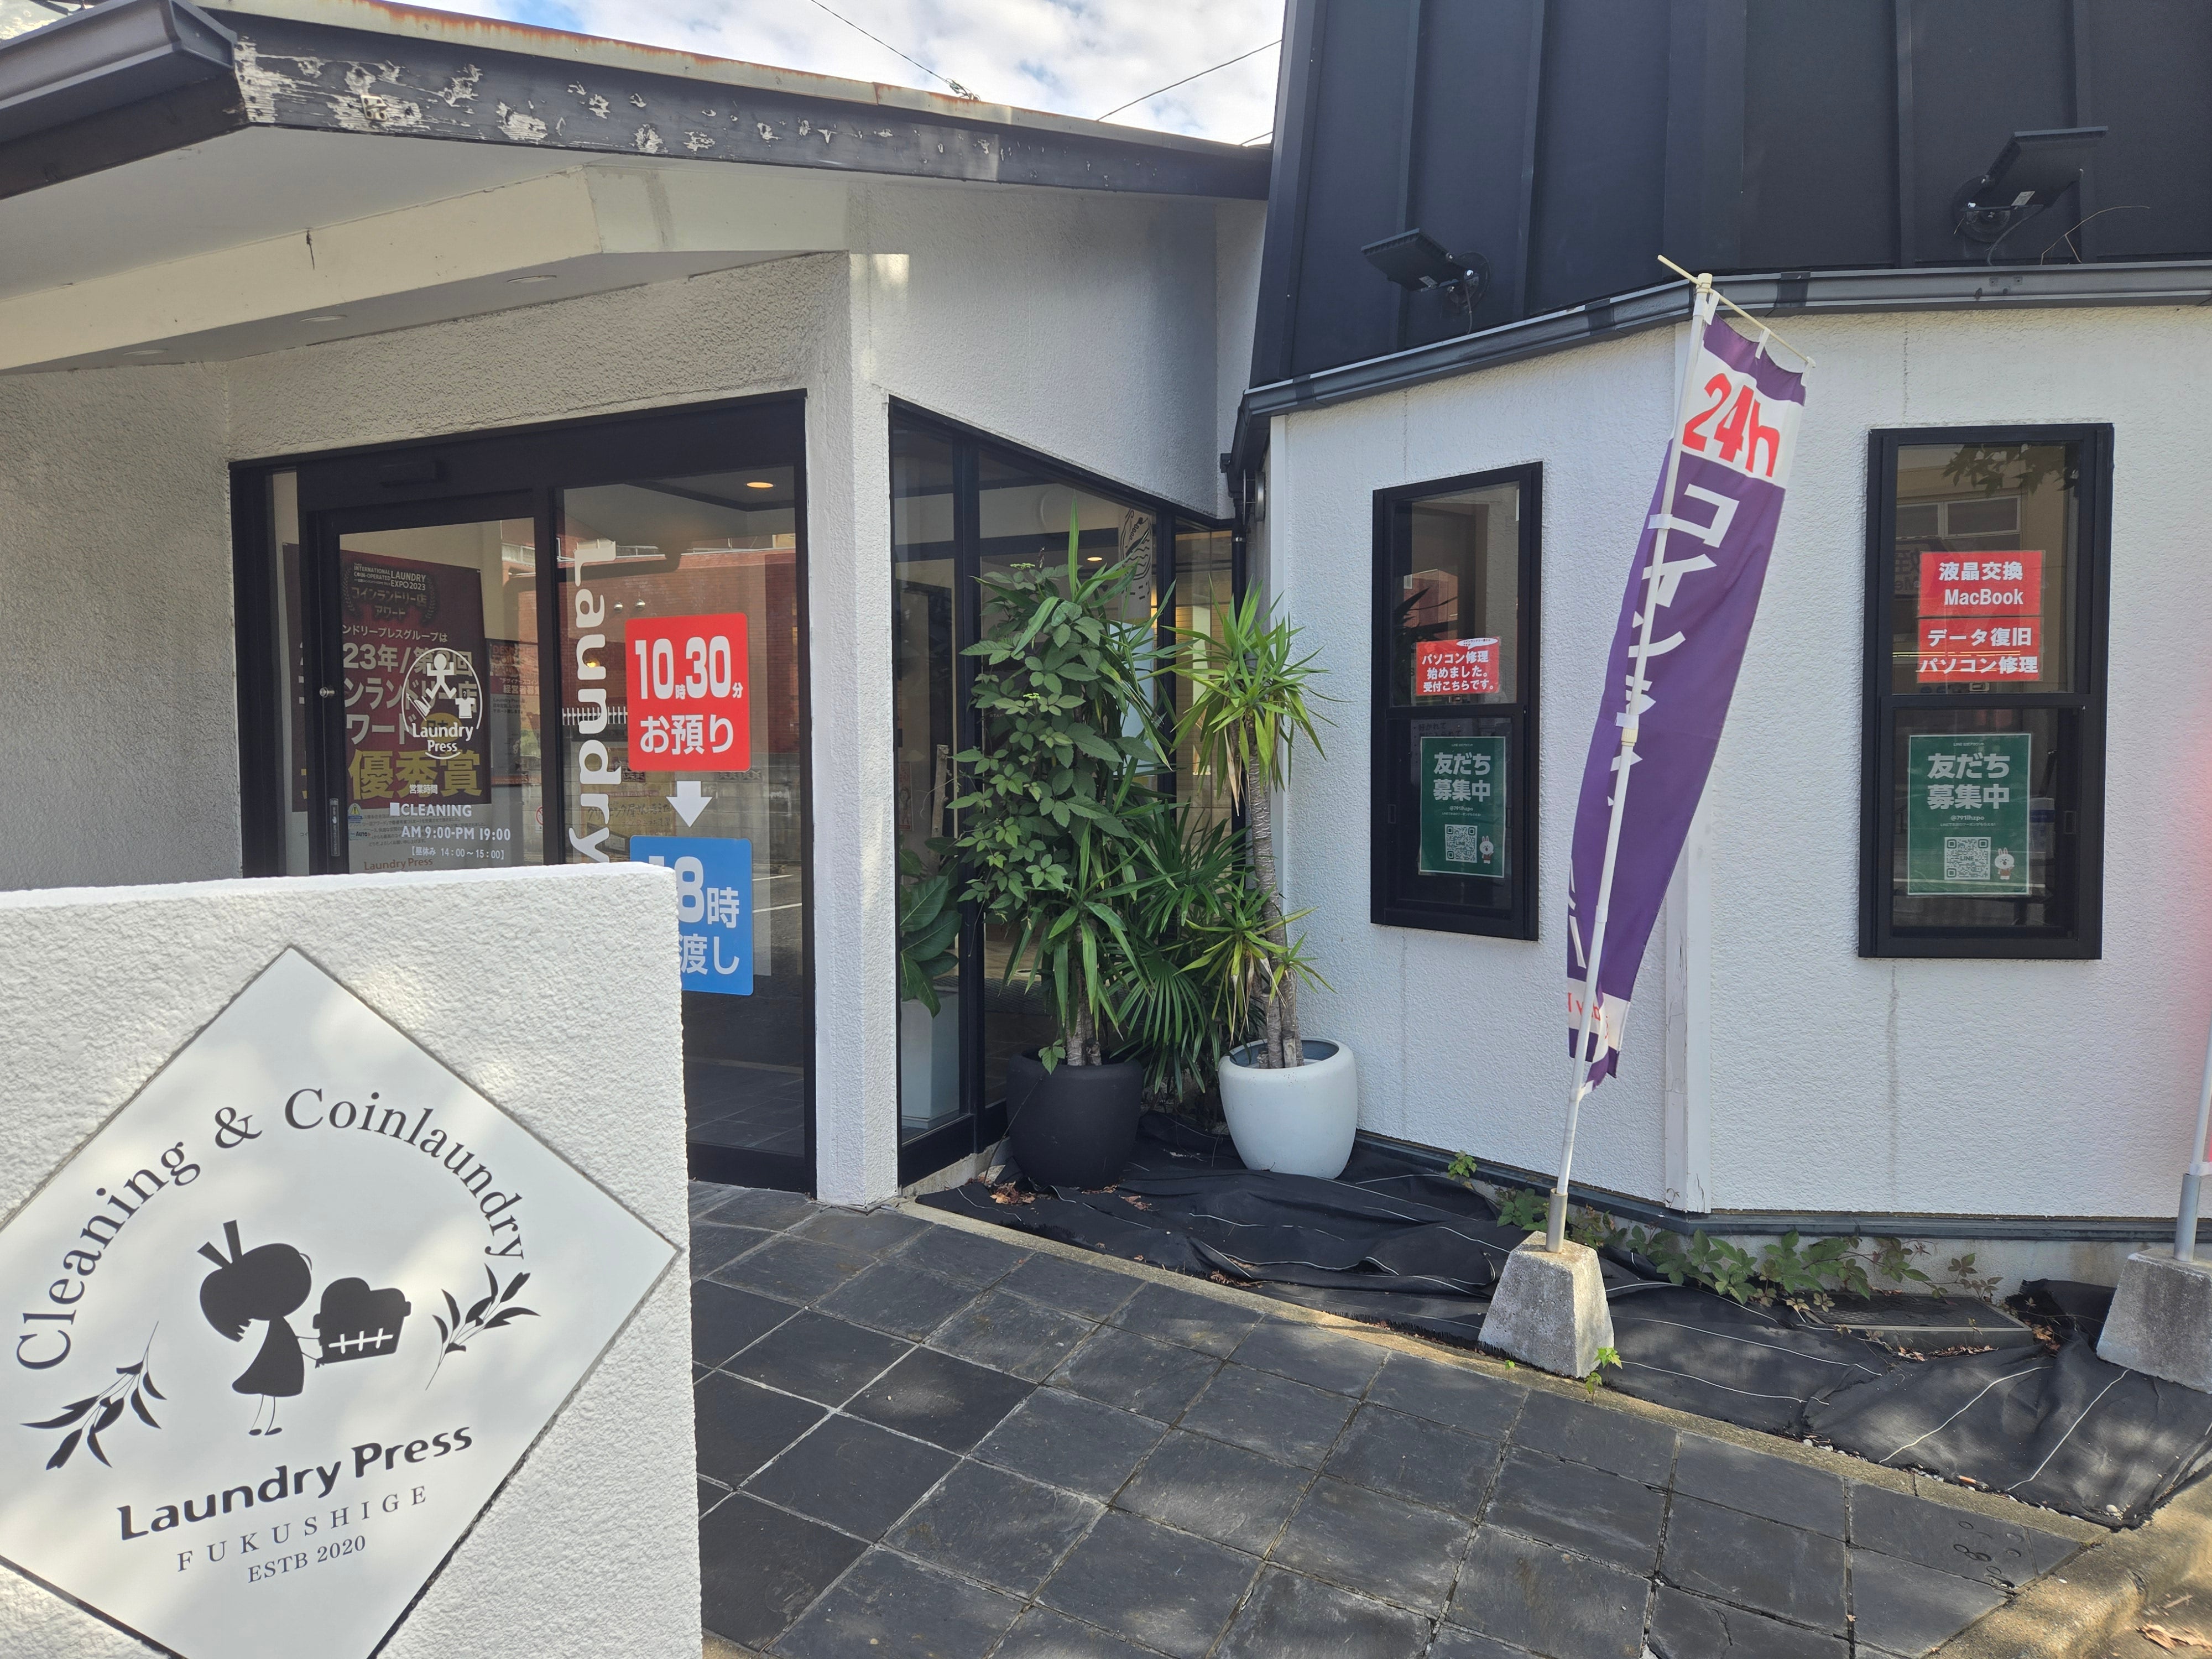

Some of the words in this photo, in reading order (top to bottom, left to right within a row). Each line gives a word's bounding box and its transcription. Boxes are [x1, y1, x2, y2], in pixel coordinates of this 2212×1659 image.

[1683, 373, 1780, 477] 24h
[354, 565, 390, 575] INTERNATIONAL
[390, 570, 426, 582] LAUNDRY
[1938, 561, 2023, 581] 液晶交換
[351, 586, 427, 608] コインランドリー店
[1944, 588, 2024, 606] MacBook
[374, 605, 406, 620] アワード
[1927, 628, 2032, 647] データ復旧
[1422, 650, 1489, 665] パソコン修理
[1919, 656, 2039, 674] パソコン修理
[1427, 665, 1488, 680] 始めました。
[1423, 679, 1494, 692] 受付こちらです。
[568, 540, 622, 863] Laundry
[412, 722, 474, 742] Laundry
[640, 714, 734, 755] お預り
[427, 739, 458, 752] Press
[1433, 752, 1491, 775] 友だち
[1927, 752, 2011, 779] 友だち
[348, 748, 483, 800] 優秀賞
[409, 784, 438, 795] 営業時間
[1433, 779, 1491, 802] 募集中
[1927, 784, 2010, 810] 募集中
[400, 804, 472, 817] CLEANING
[401, 826, 421, 838] AM
[479, 828, 511, 841] 19:00
[363, 859, 407, 872] Laundry
[408, 857, 433, 868] Press
[649, 855, 740, 928] 8時
[16, 1141, 201, 1370] Cleaning
[214, 1106, 263, 1149] &
[284, 1087, 525, 1260] Coinlaundry
[117, 1460, 342, 1541] Laundry
[351, 1426, 473, 1479] Press
[176, 1485, 427, 1572] FUKUSHIGE
[248, 1551, 308, 1584] ESTB
[317, 1535, 366, 1563] 2020
